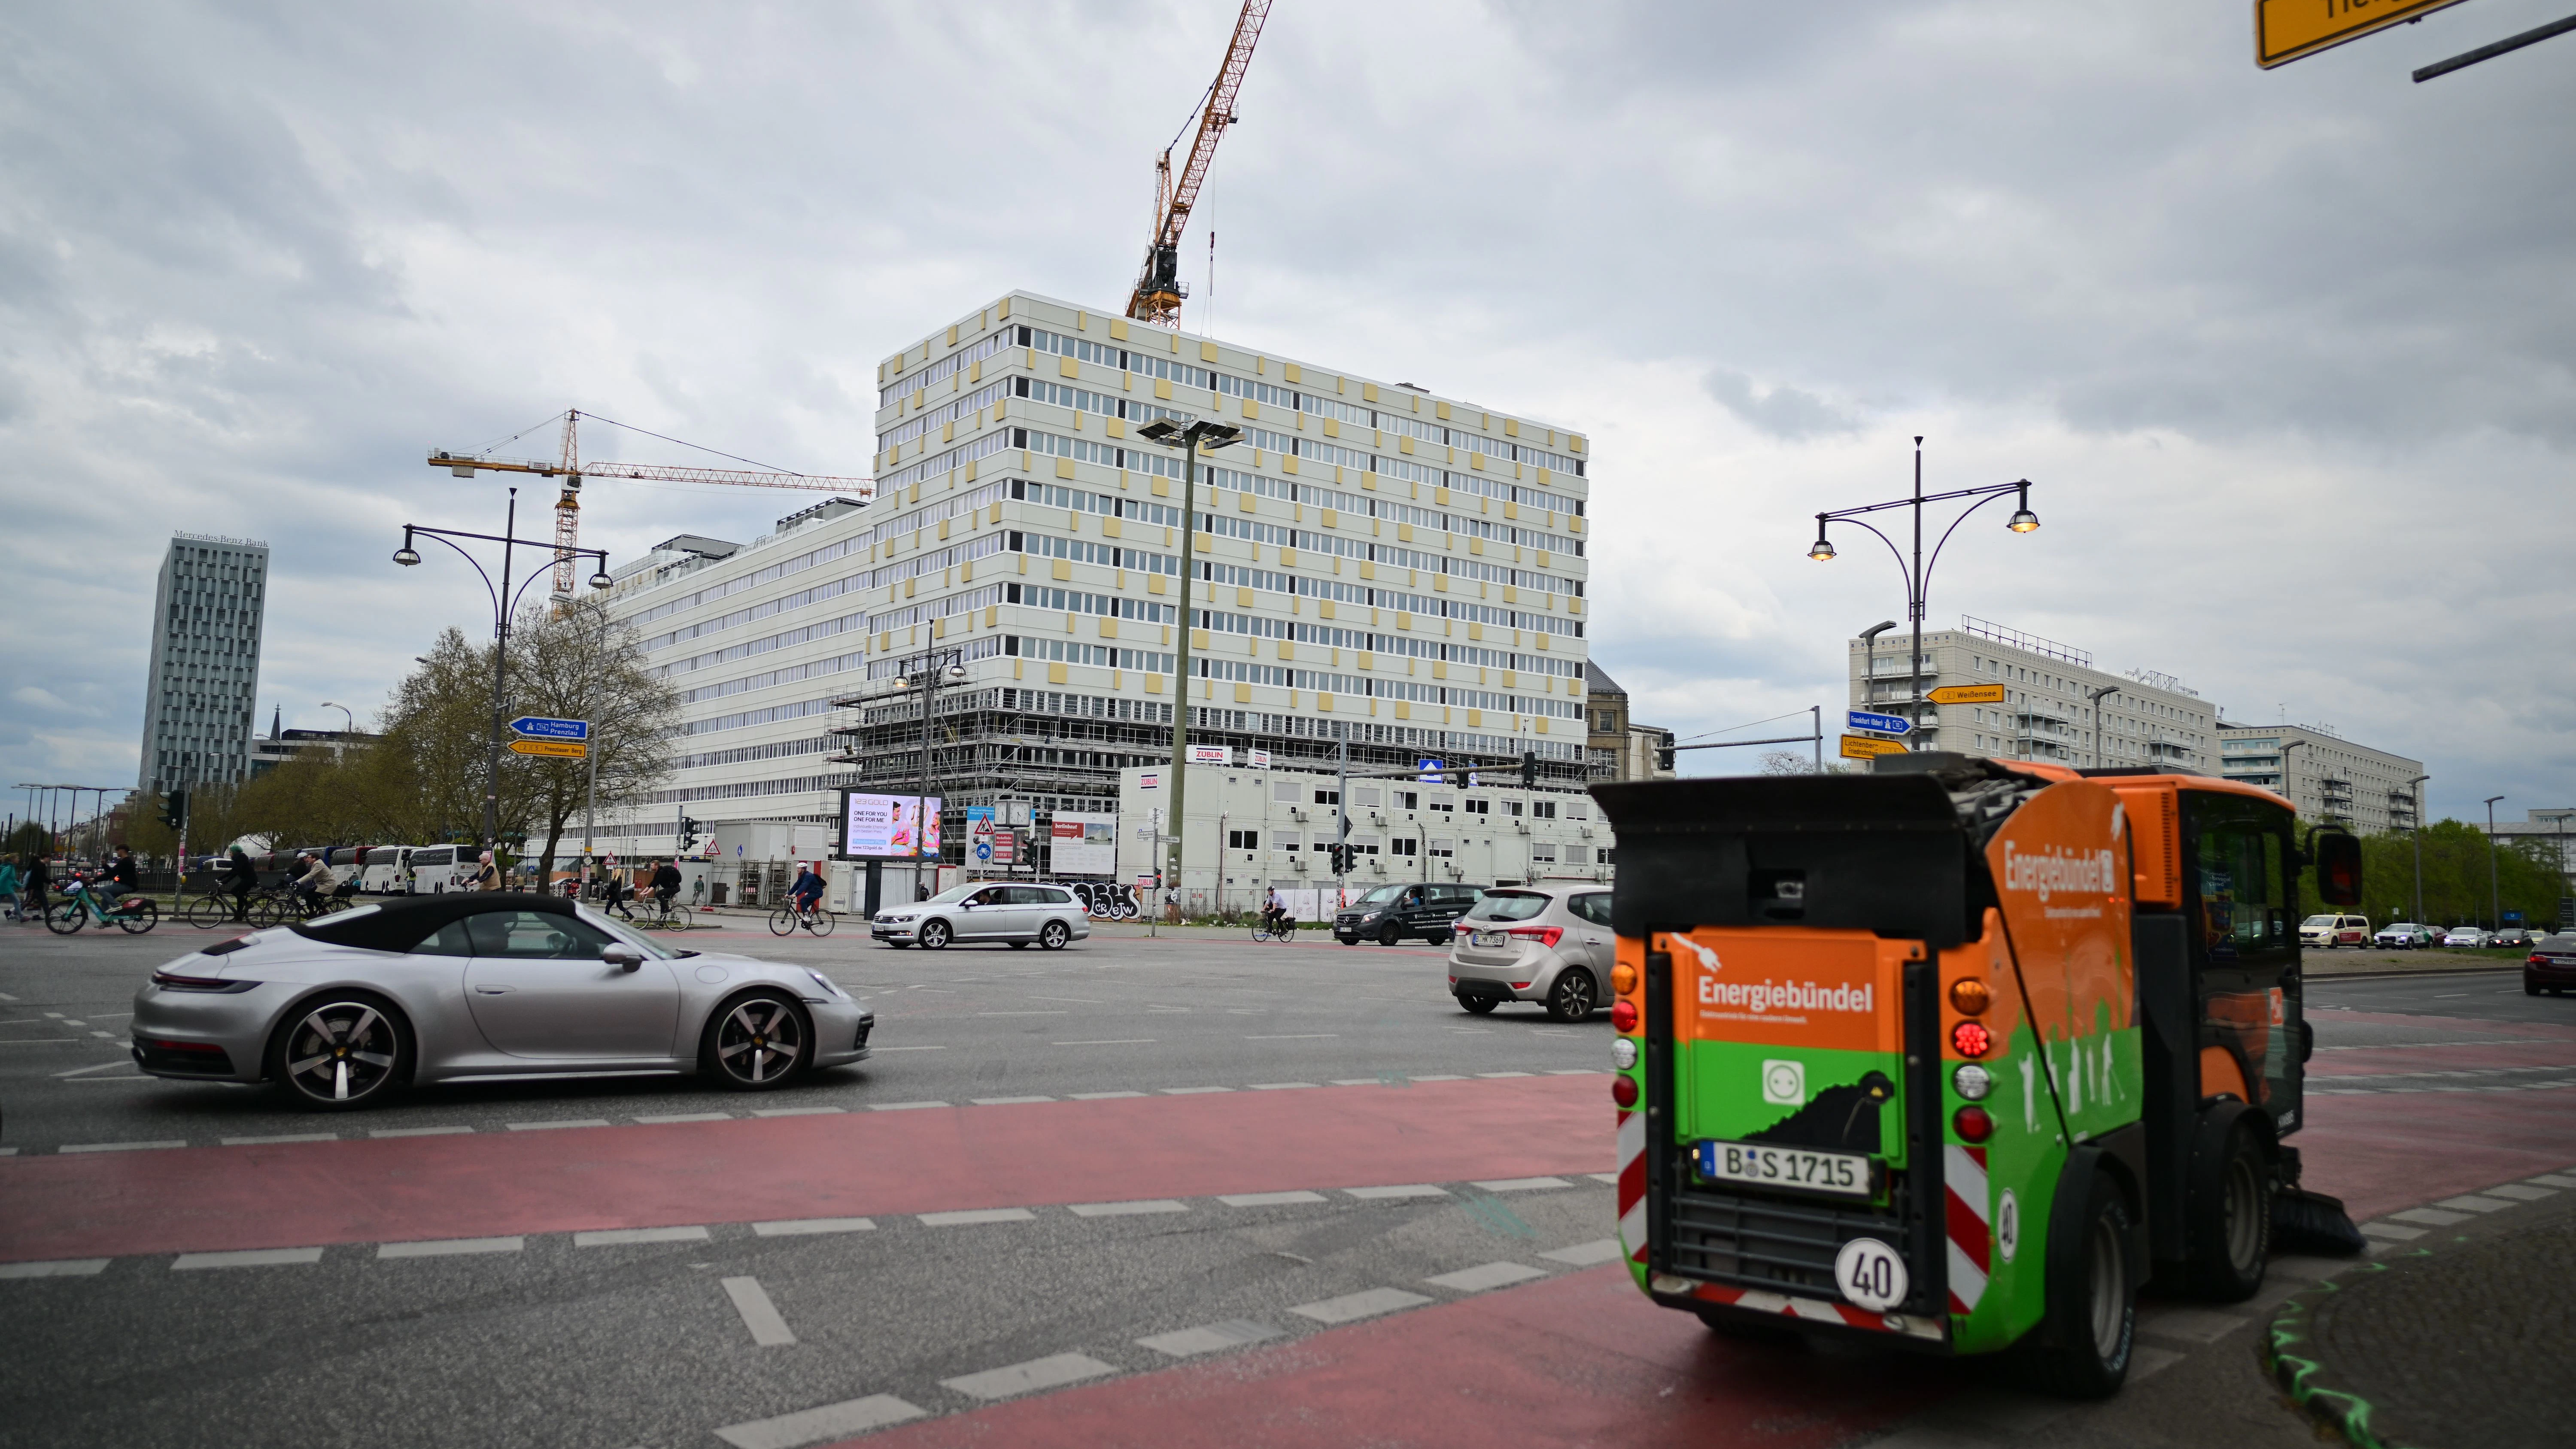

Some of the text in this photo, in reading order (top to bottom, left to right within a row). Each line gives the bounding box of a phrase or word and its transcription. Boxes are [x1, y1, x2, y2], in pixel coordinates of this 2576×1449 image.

[174, 530, 268, 547] Mercedes-Benz Bank
[550, 721, 579, 730] Hamburg
[1851, 716, 1869, 725] Frankfurt
[1871, 718, 1883, 726] (Oder)
[2004, 840, 2100, 903] Energiebündel
[1698, 975, 1873, 1013] Energiebündel
[1726, 1148, 1742, 1173] B
[1762, 1152, 1778, 1178] S
[1785, 1154, 1853, 1187] 1715
[1851, 1252, 1892, 1299] 40
